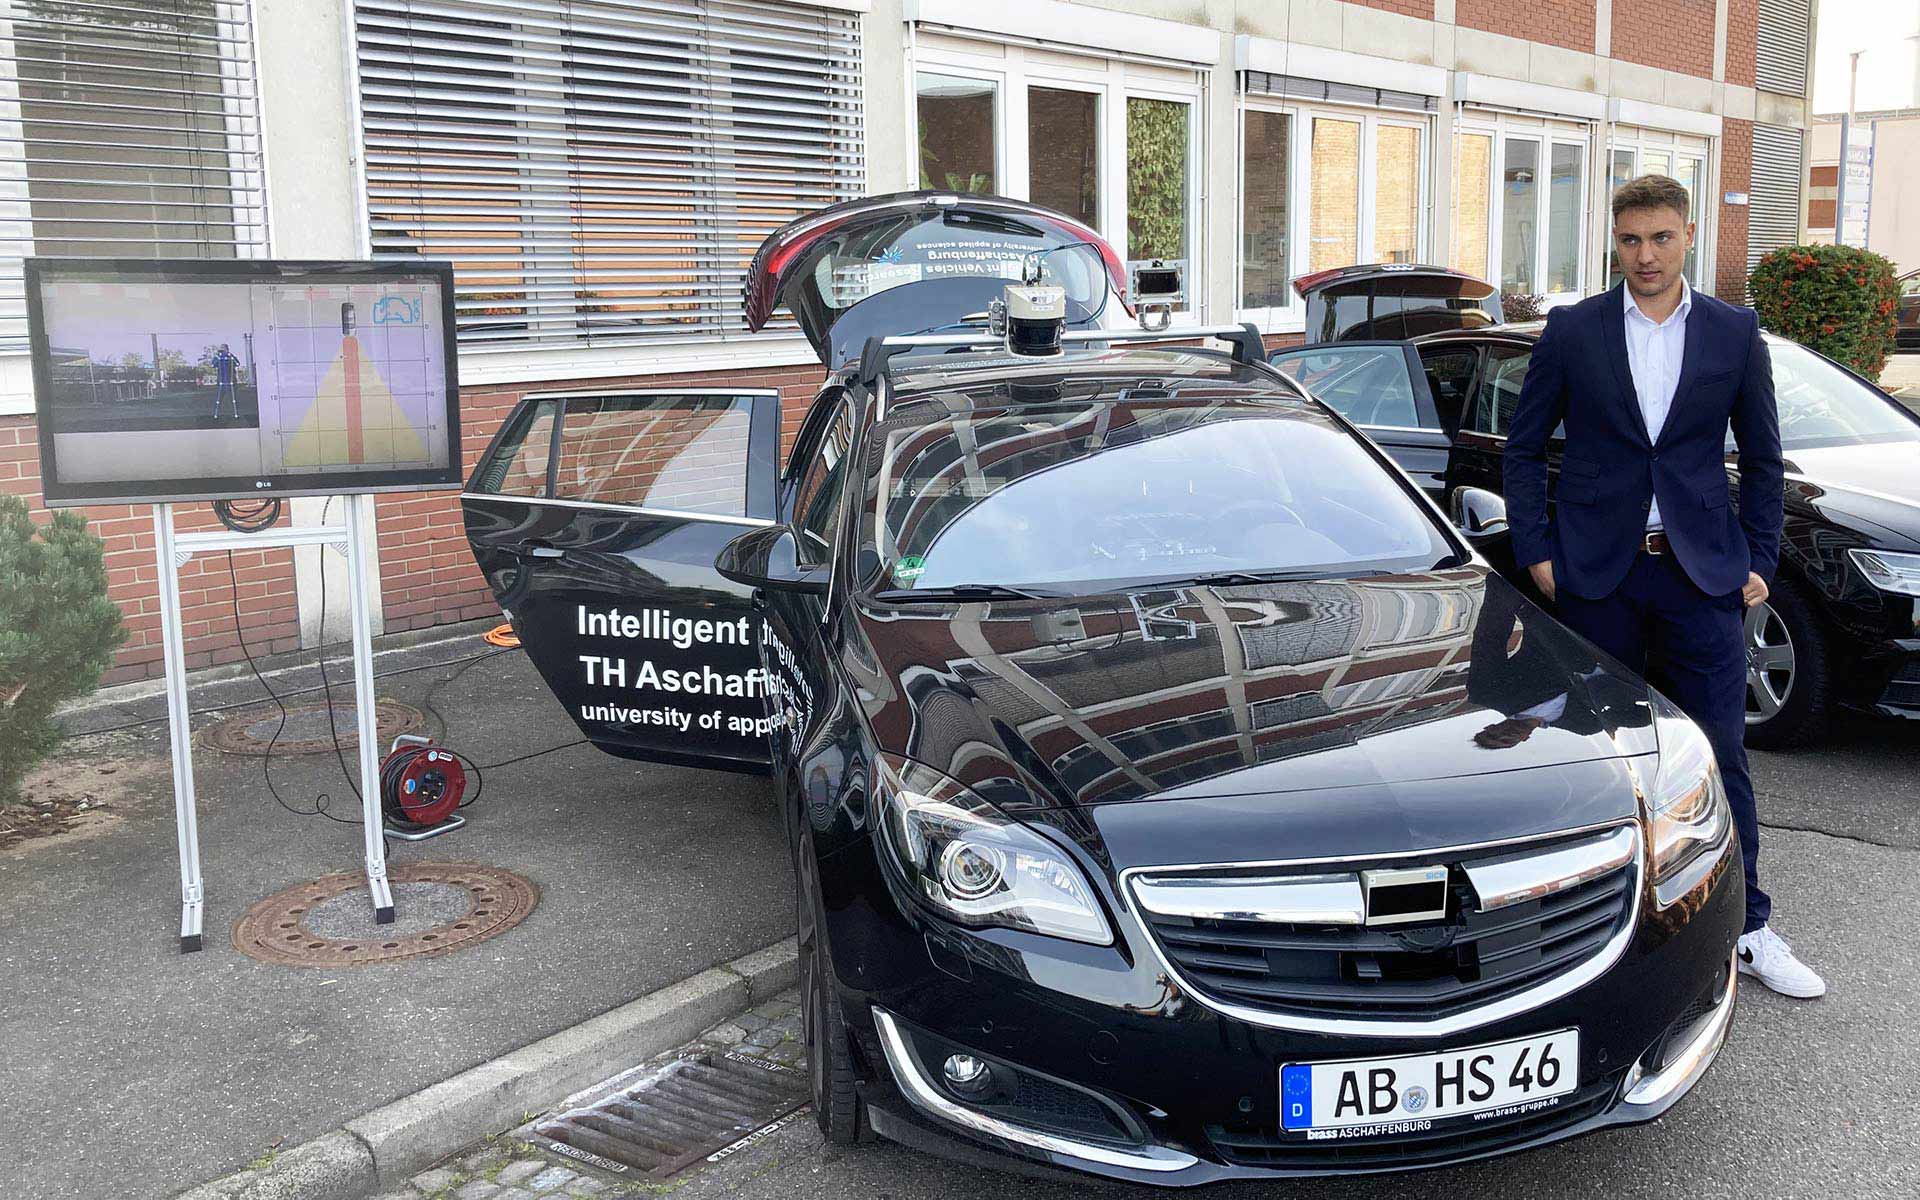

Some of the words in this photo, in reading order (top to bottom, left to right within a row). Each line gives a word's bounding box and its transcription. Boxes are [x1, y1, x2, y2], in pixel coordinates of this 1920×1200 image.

[928, 250, 1026, 261] Aschaffenburg
[992, 241, 1001, 249] of
[925, 261, 984, 273] Vehicles
[577, 604, 750, 650] Intelligent
[579, 655, 626, 688] TH
[581, 702, 692, 732] university
[698, 710, 722, 730] of
[1334, 1067, 1399, 1118] AB
[1434, 1054, 1496, 1109] HS
[1508, 1041, 1562, 1093] 46
[1291, 1103, 1304, 1118] D
[1473, 1096, 1559, 1121] www.brass-gruppe.de
[1307, 1129, 1338, 1140] brass
[1339, 1120, 1432, 1139] ASCHAFFENBURG
